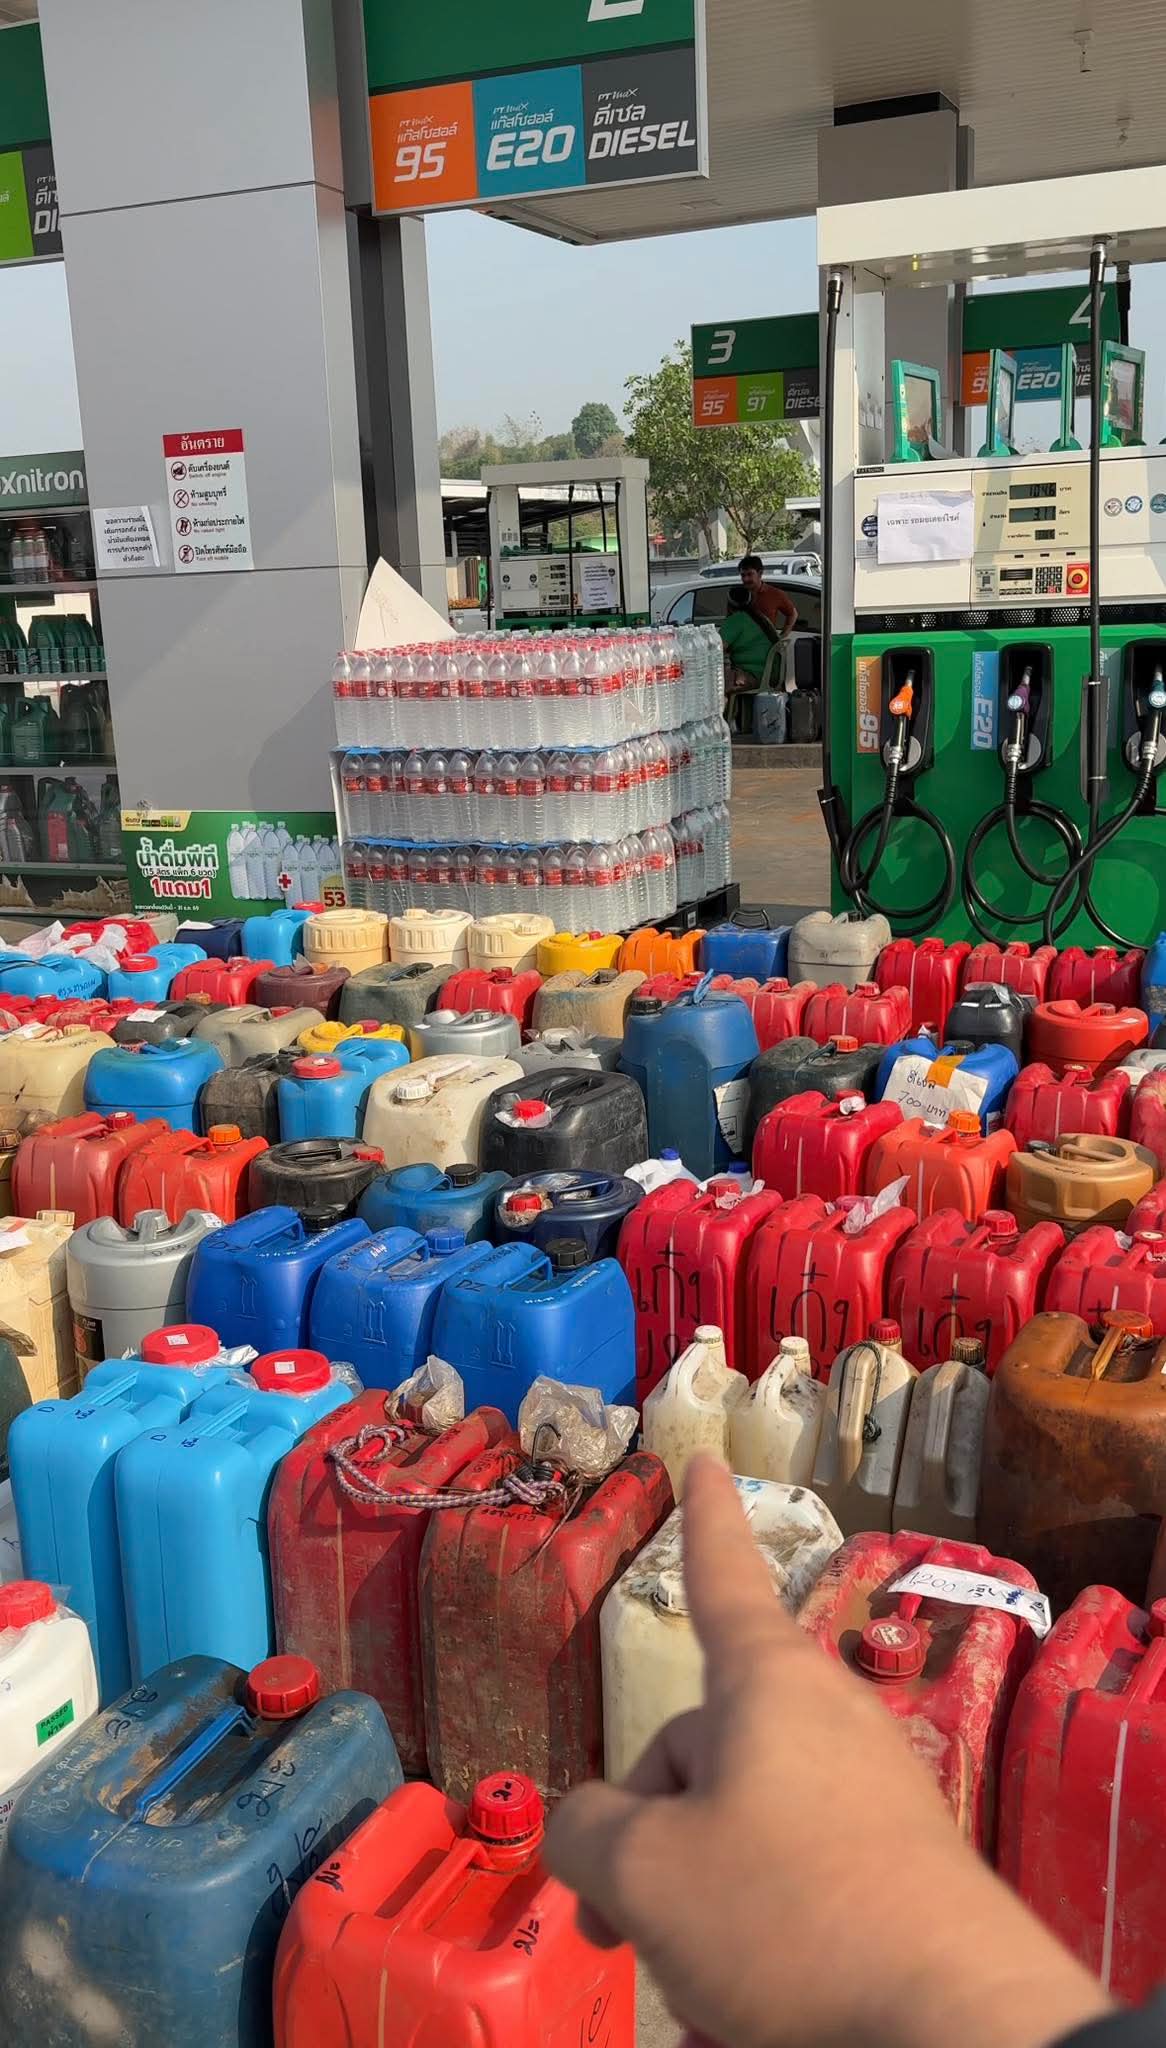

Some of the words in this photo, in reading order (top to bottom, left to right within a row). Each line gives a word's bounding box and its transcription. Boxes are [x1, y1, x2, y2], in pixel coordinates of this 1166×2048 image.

[491, 109, 554, 130] แก๊สโซฮอล์
[593, 103, 646, 127] ดีเซล
[397, 122, 458, 143] แก๊สโซฮอล์
[588, 120, 697, 160] DIESEL
[486, 125, 575, 171] E20
[394, 142, 447, 183] 95
[33, 208, 61, 235] DI
[1069, 291, 1106, 329] 4
[707, 329, 736, 365] 3
[1016, 371, 1061, 391] E20
[701, 400, 725, 416] 95
[746, 396, 767, 412] 91
[785, 396, 825, 410] DIESE
[180, 434, 225, 451] อันตราย
[188, 460, 231, 473] ดับเครื่องยนต์
[0, 468, 84, 495] xnitron
[190, 487, 227, 502] ห้ามสูบบุหรี่
[192, 514, 245, 528] ห้ามก่อประกายไฟ
[195, 543, 247, 556] ปิดโทรศัพท์มือถือ
[859, 714, 879, 750] 95
[972, 699, 993, 748] E20
[137, 837, 218, 868] น้ำดื่มพีที
[151, 877, 211, 898] 1แถม1
[323, 890, 346, 908] 53
[898, 1090, 922, 1108] 700
[926, 1104, 947, 1118] บาท
[908, 1571, 957, 1594] 1,200
[40, 1704, 69, 1730] PASSED
